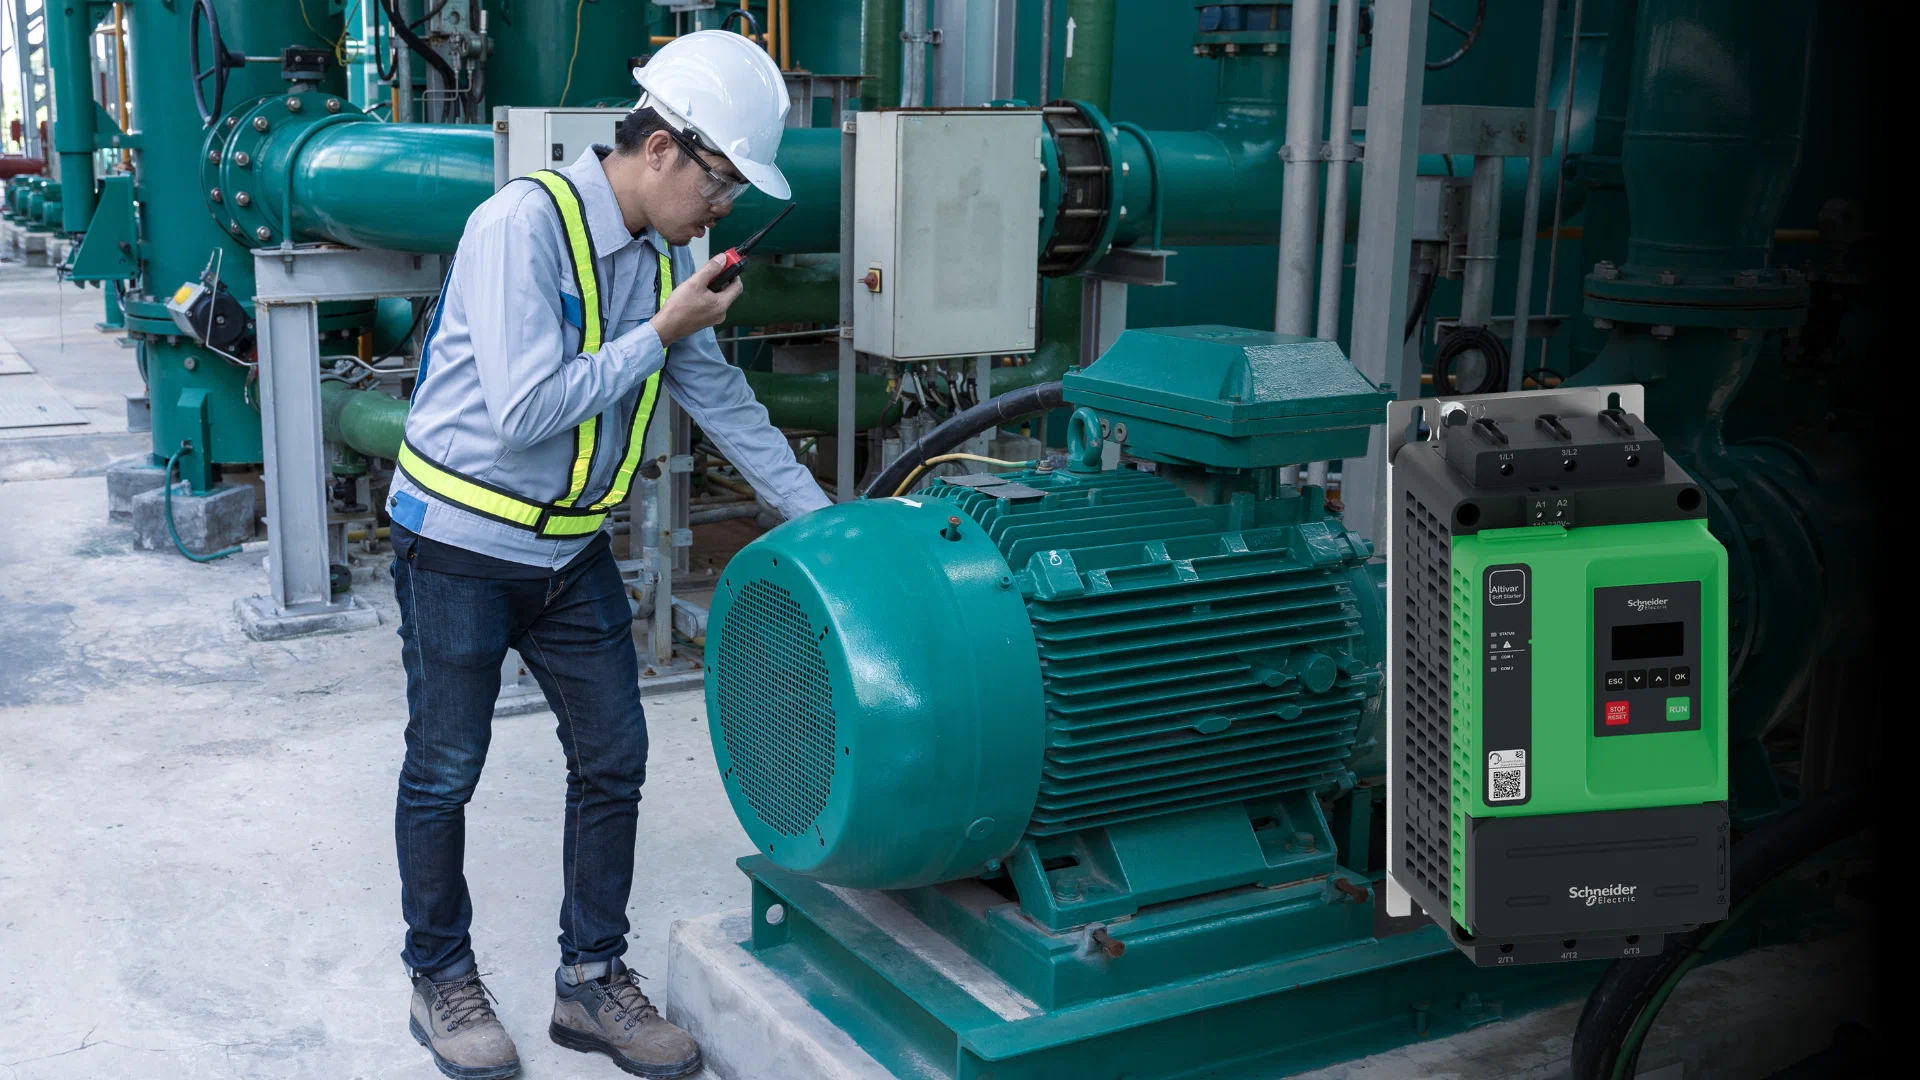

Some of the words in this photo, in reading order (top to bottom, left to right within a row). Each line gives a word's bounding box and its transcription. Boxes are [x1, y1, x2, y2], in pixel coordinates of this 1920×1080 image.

[1561, 448, 1578, 456] 3/L2
[1556, 499, 1568, 507] A2
[1491, 585, 1519, 593] Altivar
[1627, 598, 1668, 608] Schneider
[1675, 673, 1686, 681] OK
[1569, 884, 1637, 899] Schneider
[1598, 896, 1636, 904] Electric
[1561, 951, 1578, 959] 4/T2
[1623, 947, 1640, 955] 6/T3
